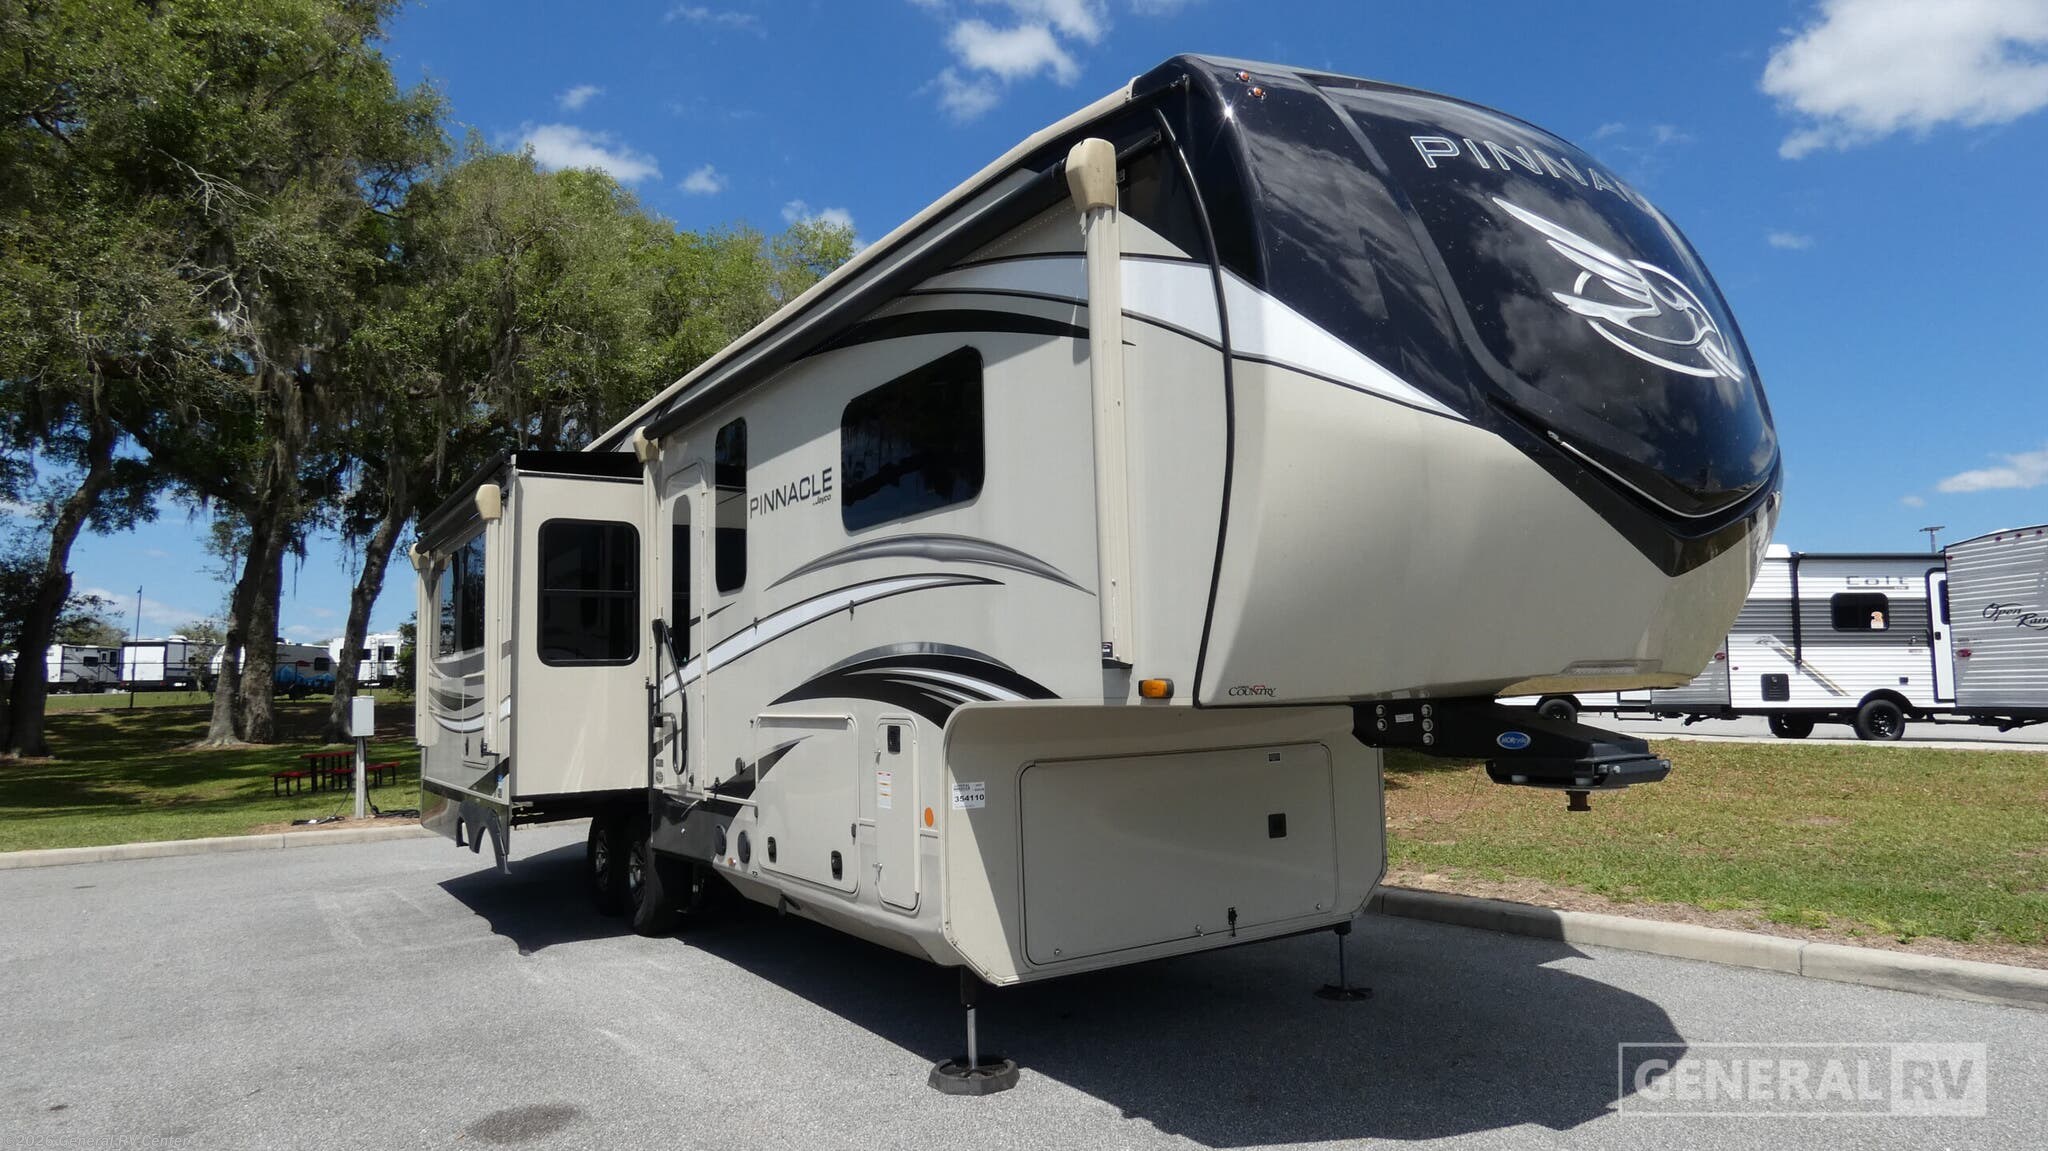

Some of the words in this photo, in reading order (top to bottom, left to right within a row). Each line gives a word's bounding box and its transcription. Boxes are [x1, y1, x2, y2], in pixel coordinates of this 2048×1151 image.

[750, 466, 832, 519] PINNACLE
[1983, 603, 2024, 621] Open
[2014, 613, 2048, 631] Ran
[1228, 685, 1277, 698] COUNTRY
[954, 793, 985, 803] 354110
